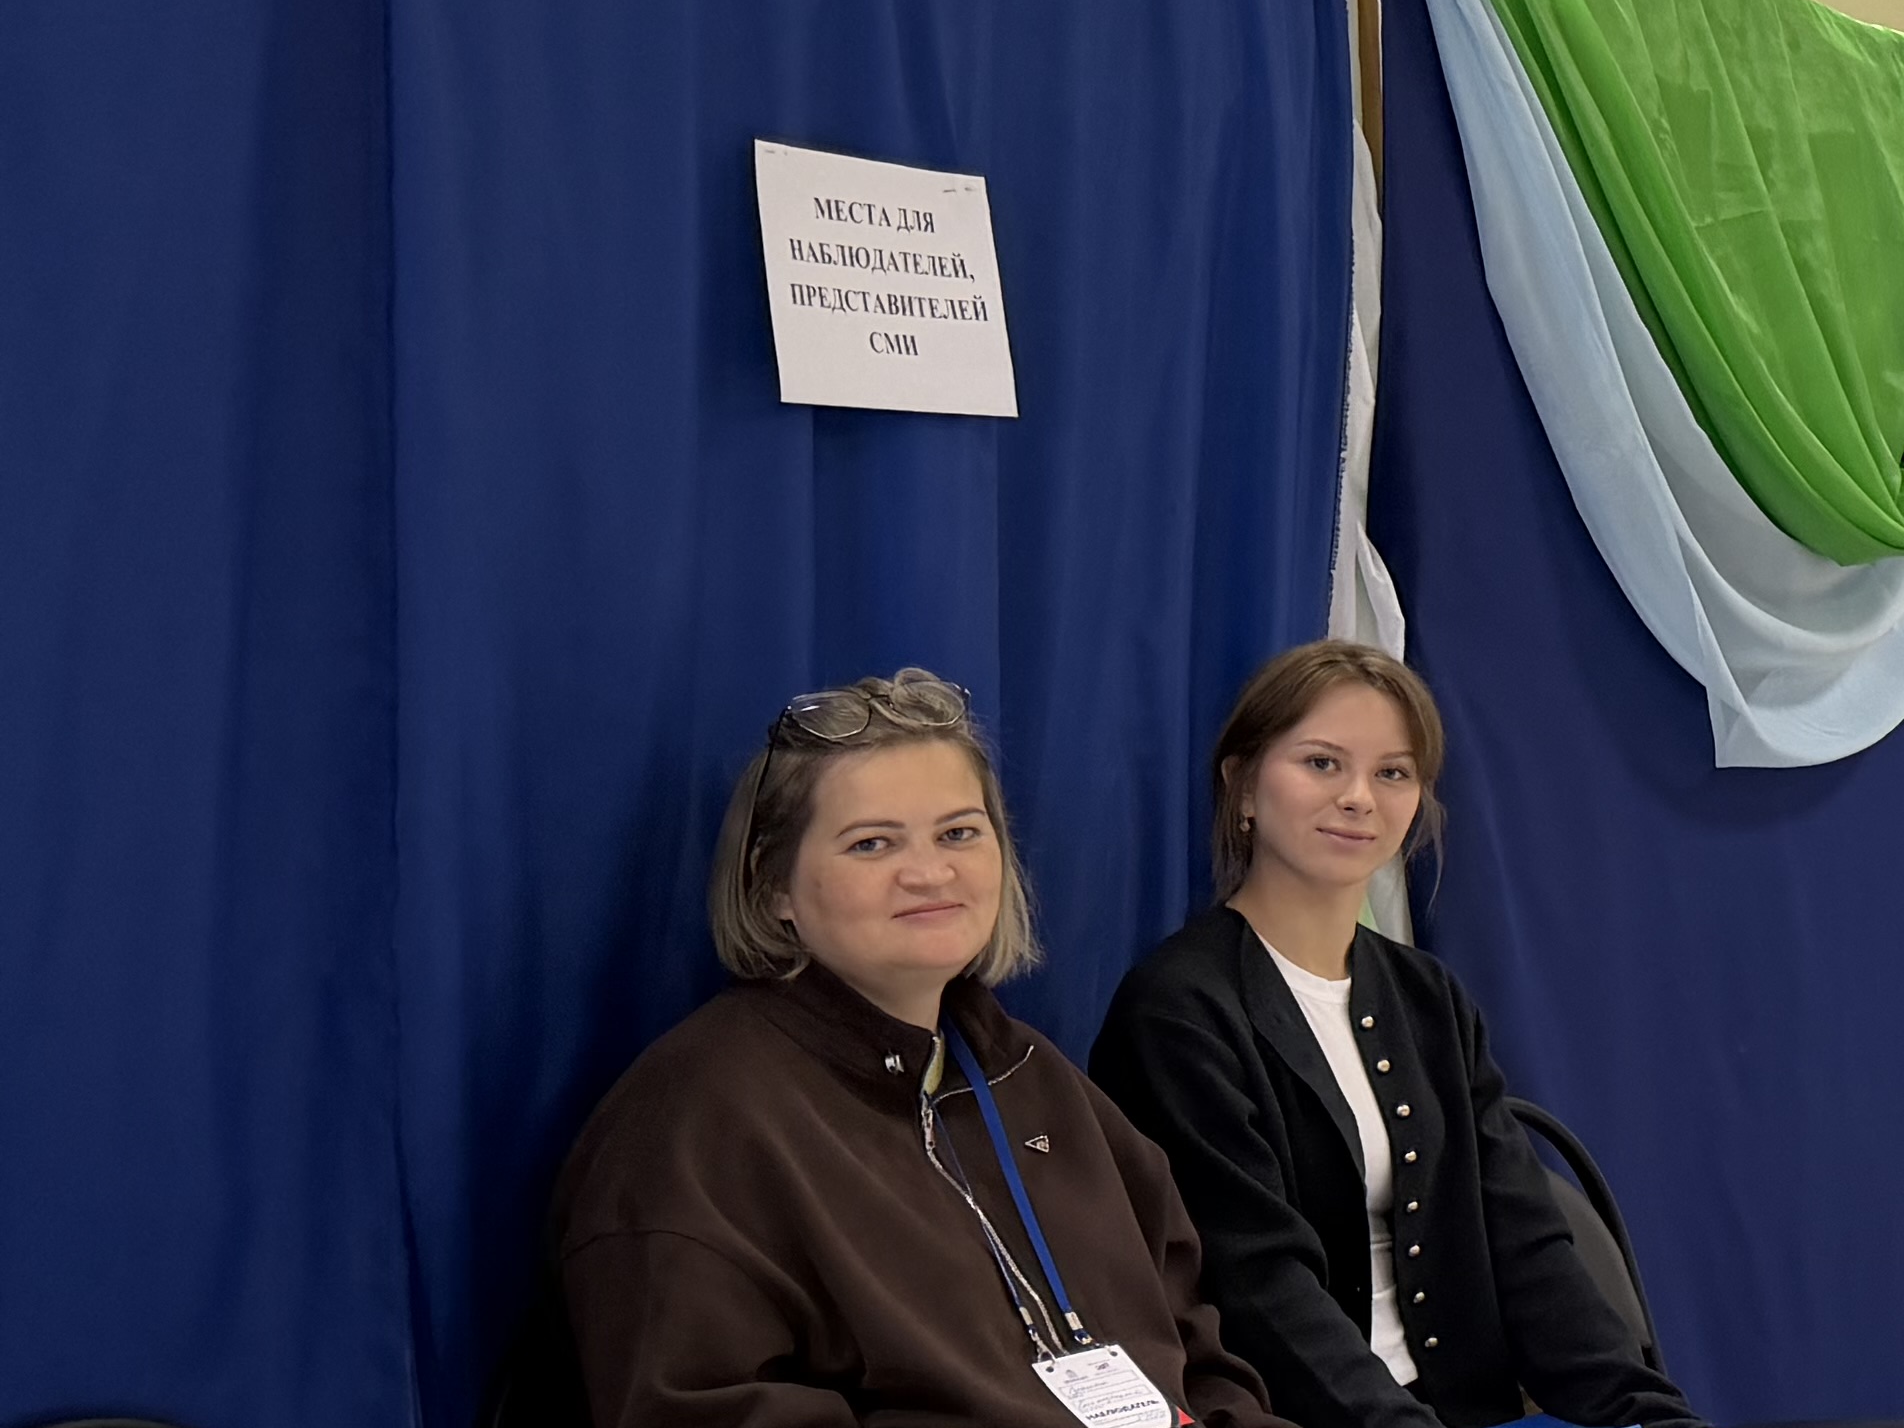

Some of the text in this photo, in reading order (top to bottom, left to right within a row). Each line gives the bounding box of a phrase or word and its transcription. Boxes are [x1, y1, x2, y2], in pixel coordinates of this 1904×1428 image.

[813, 197, 935, 233] МЕСТА ДЛЯ
[789, 238, 976, 283] НАБЛЮДАТЕЛЕЙ,
[789, 283, 989, 322] ПРЕДСТАВИТЕЛЕЙ
[868, 331, 919, 356] СМИ
